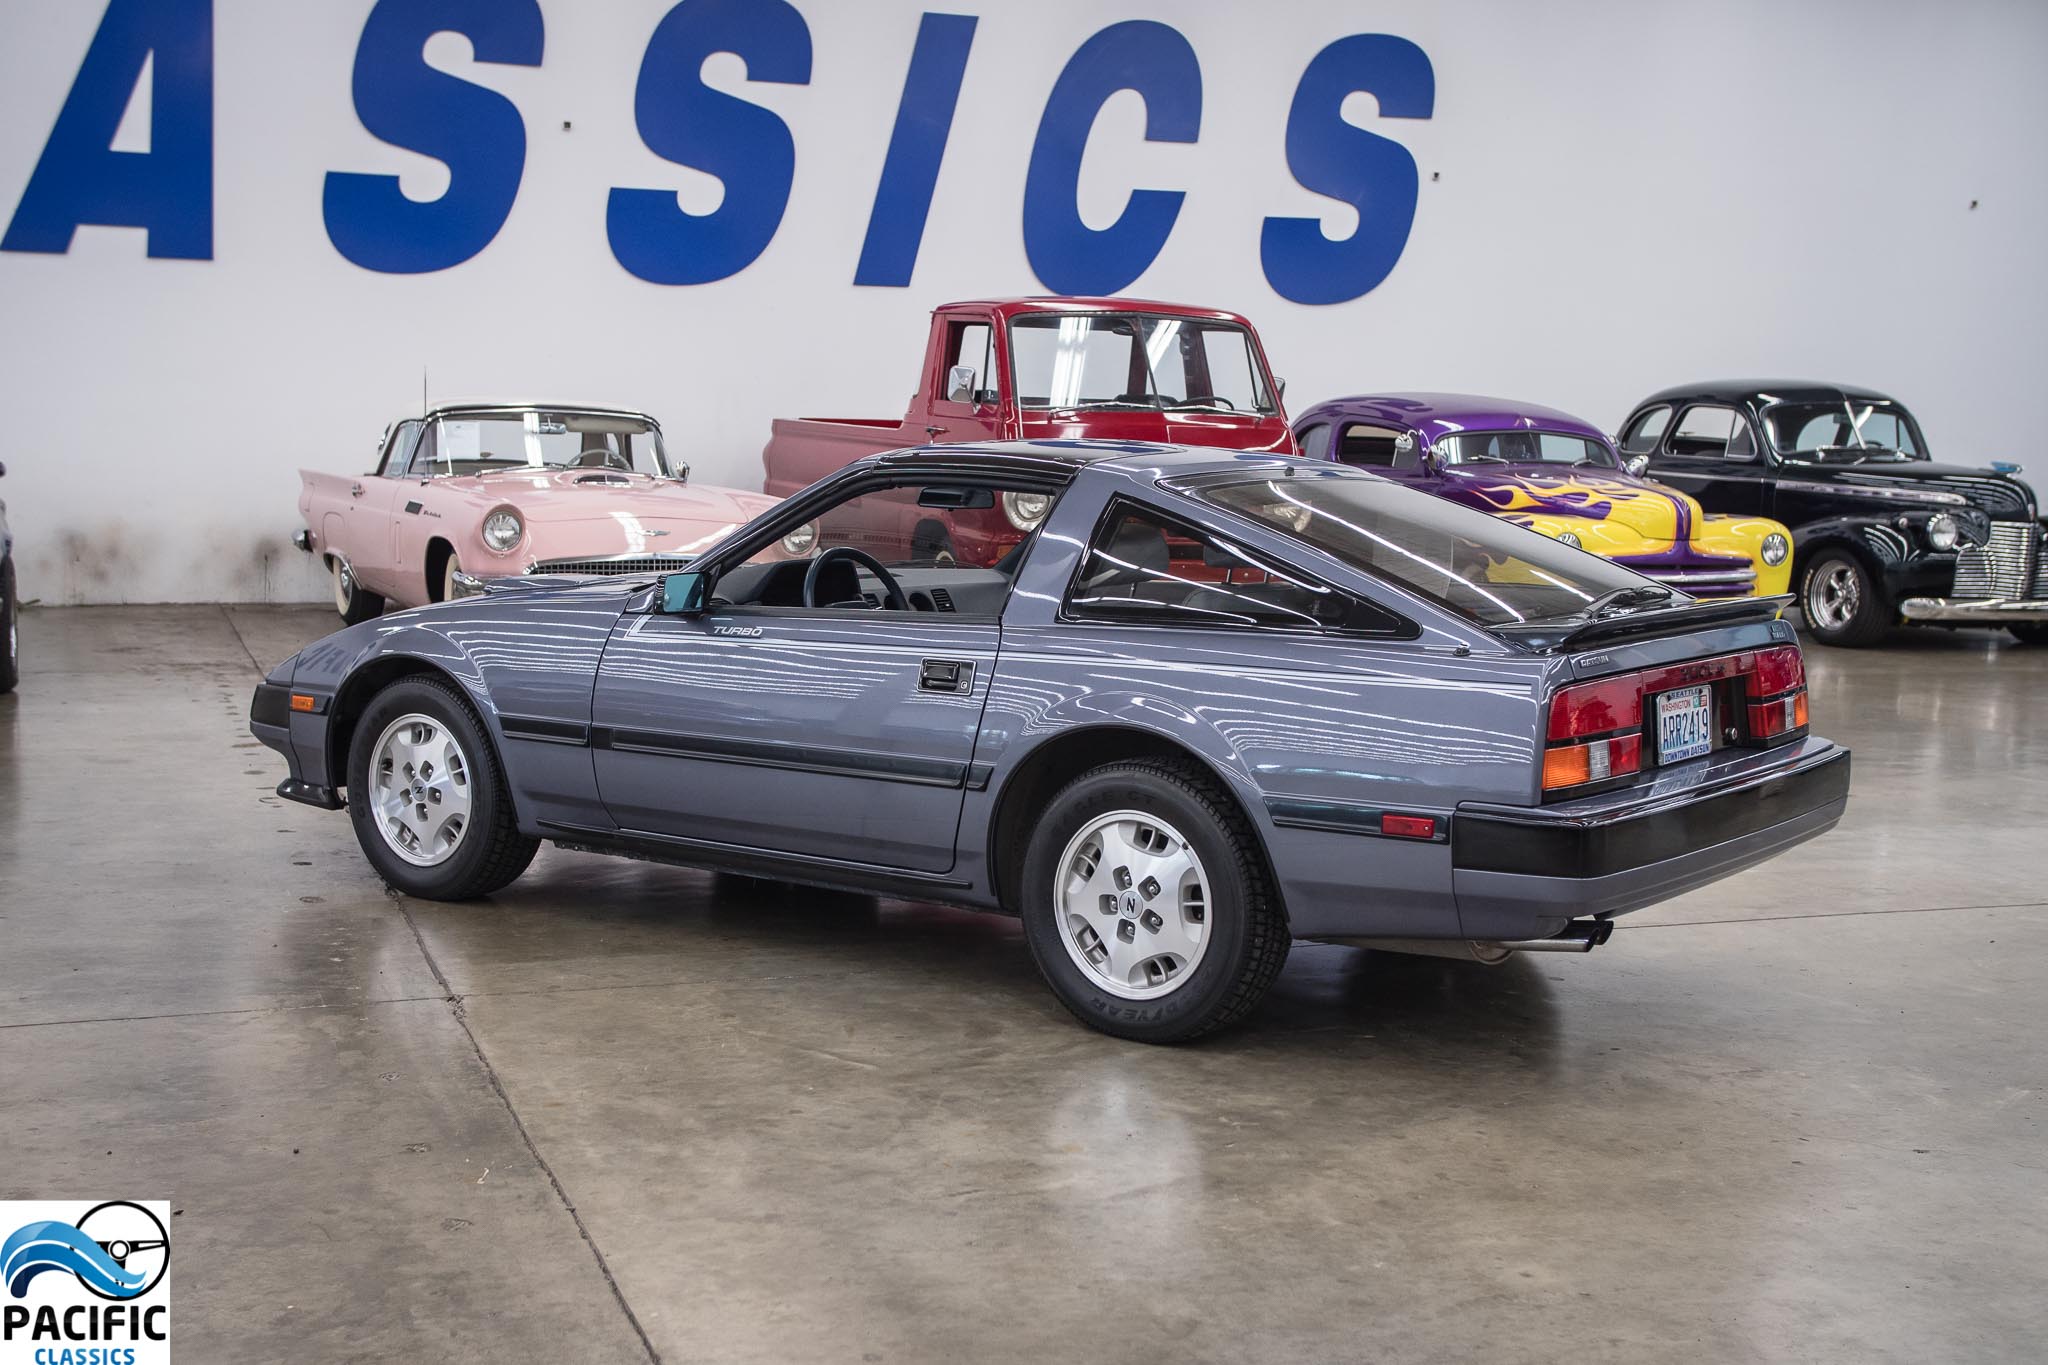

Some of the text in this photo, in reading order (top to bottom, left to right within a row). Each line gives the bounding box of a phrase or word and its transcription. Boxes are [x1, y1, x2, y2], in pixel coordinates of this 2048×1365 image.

[713, 626, 763, 636] TURBO
[1671, 688, 1698, 700] SEATTLE
[1661, 699, 1691, 713] WASHINGTON
[1663, 708, 1709, 750] ARR2419
[1664, 748, 1690, 764] DOWNTOWN
